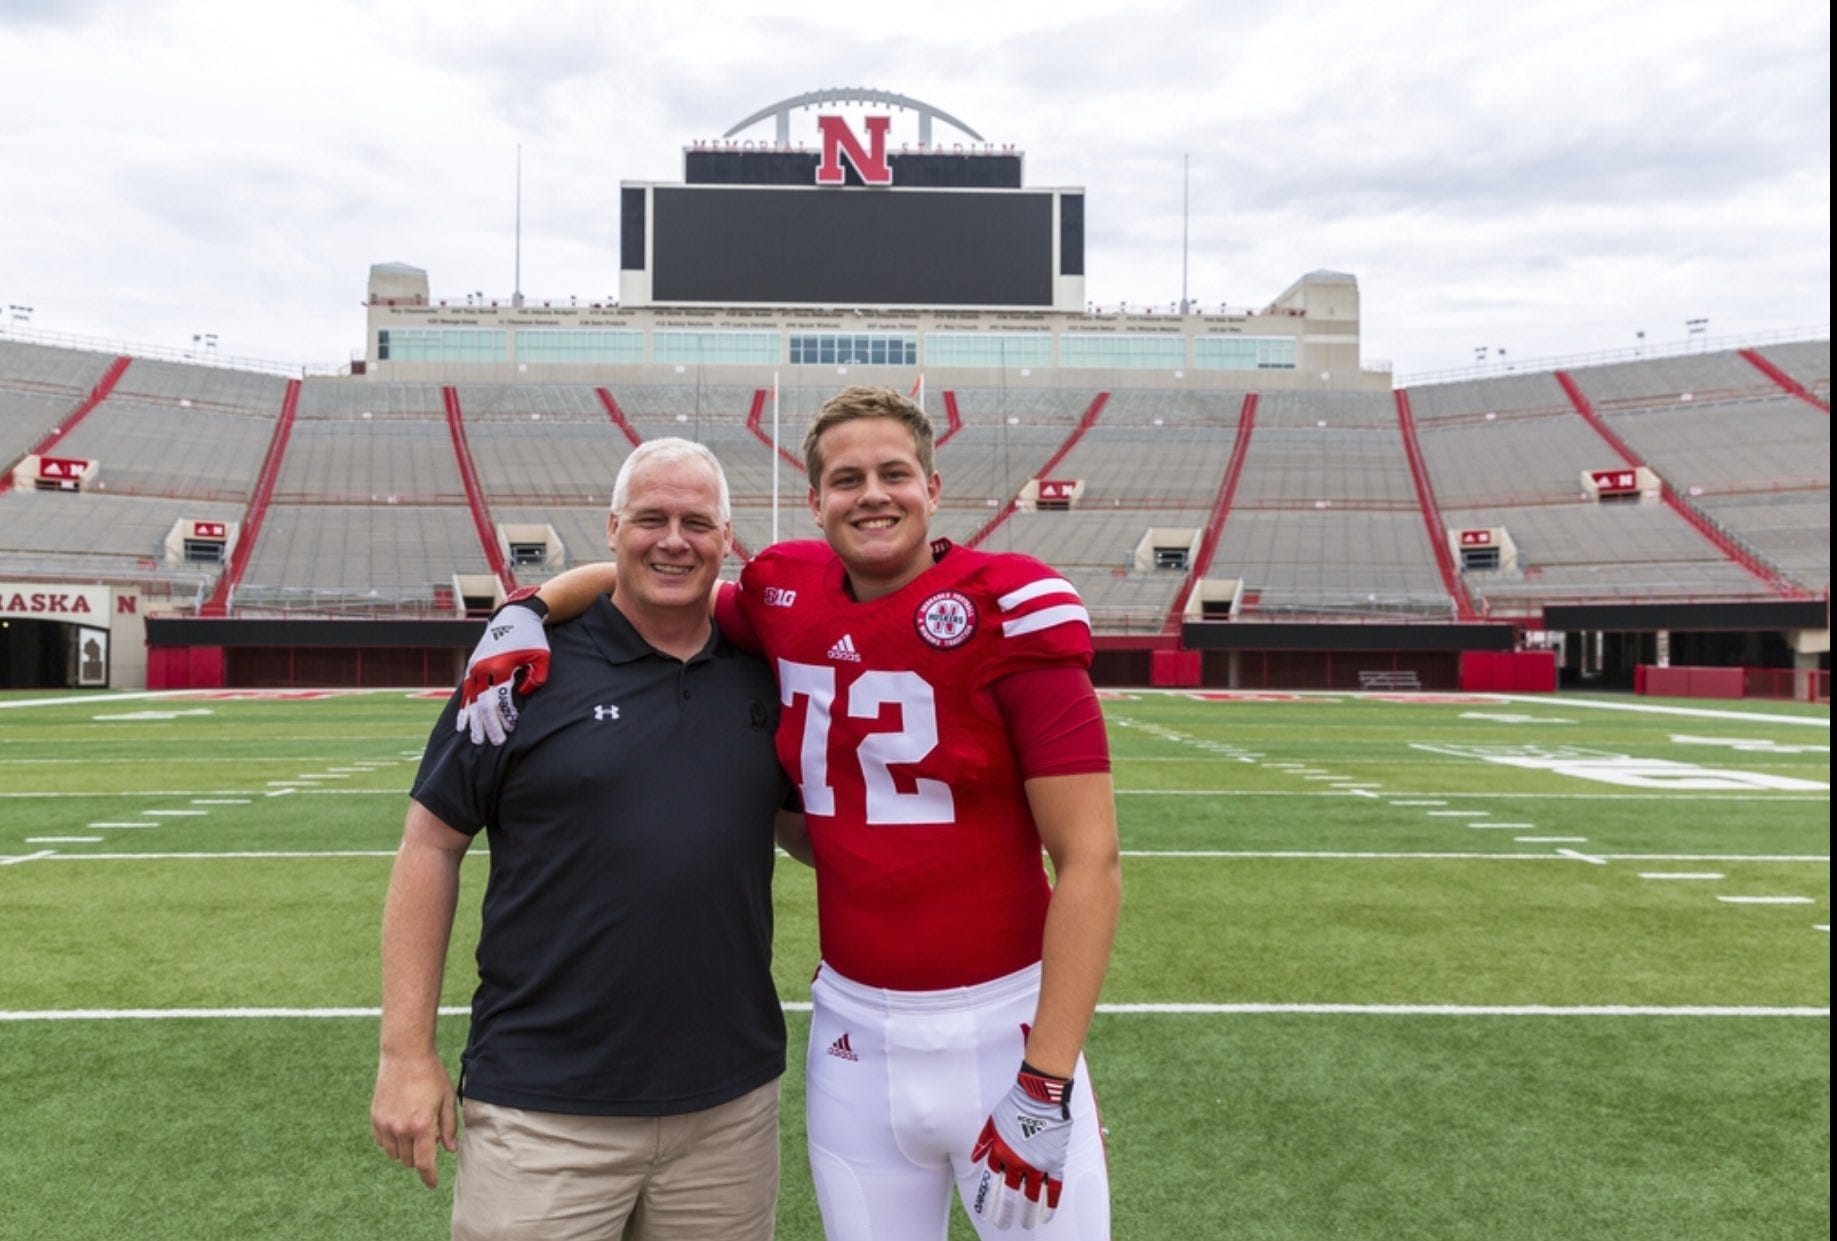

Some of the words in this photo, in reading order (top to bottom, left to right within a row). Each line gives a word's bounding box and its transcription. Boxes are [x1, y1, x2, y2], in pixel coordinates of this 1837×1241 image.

[693, 139, 808, 154] MEMORIAL
[900, 142, 1016, 157] STADIUM
[816, 116, 892, 185] N
[0, 594, 91, 613] ASKA
[117, 596, 136, 614] N
[827, 650, 862, 663] adidas
[777, 657, 956, 826] 72
[827, 1047, 858, 1062] adidas
